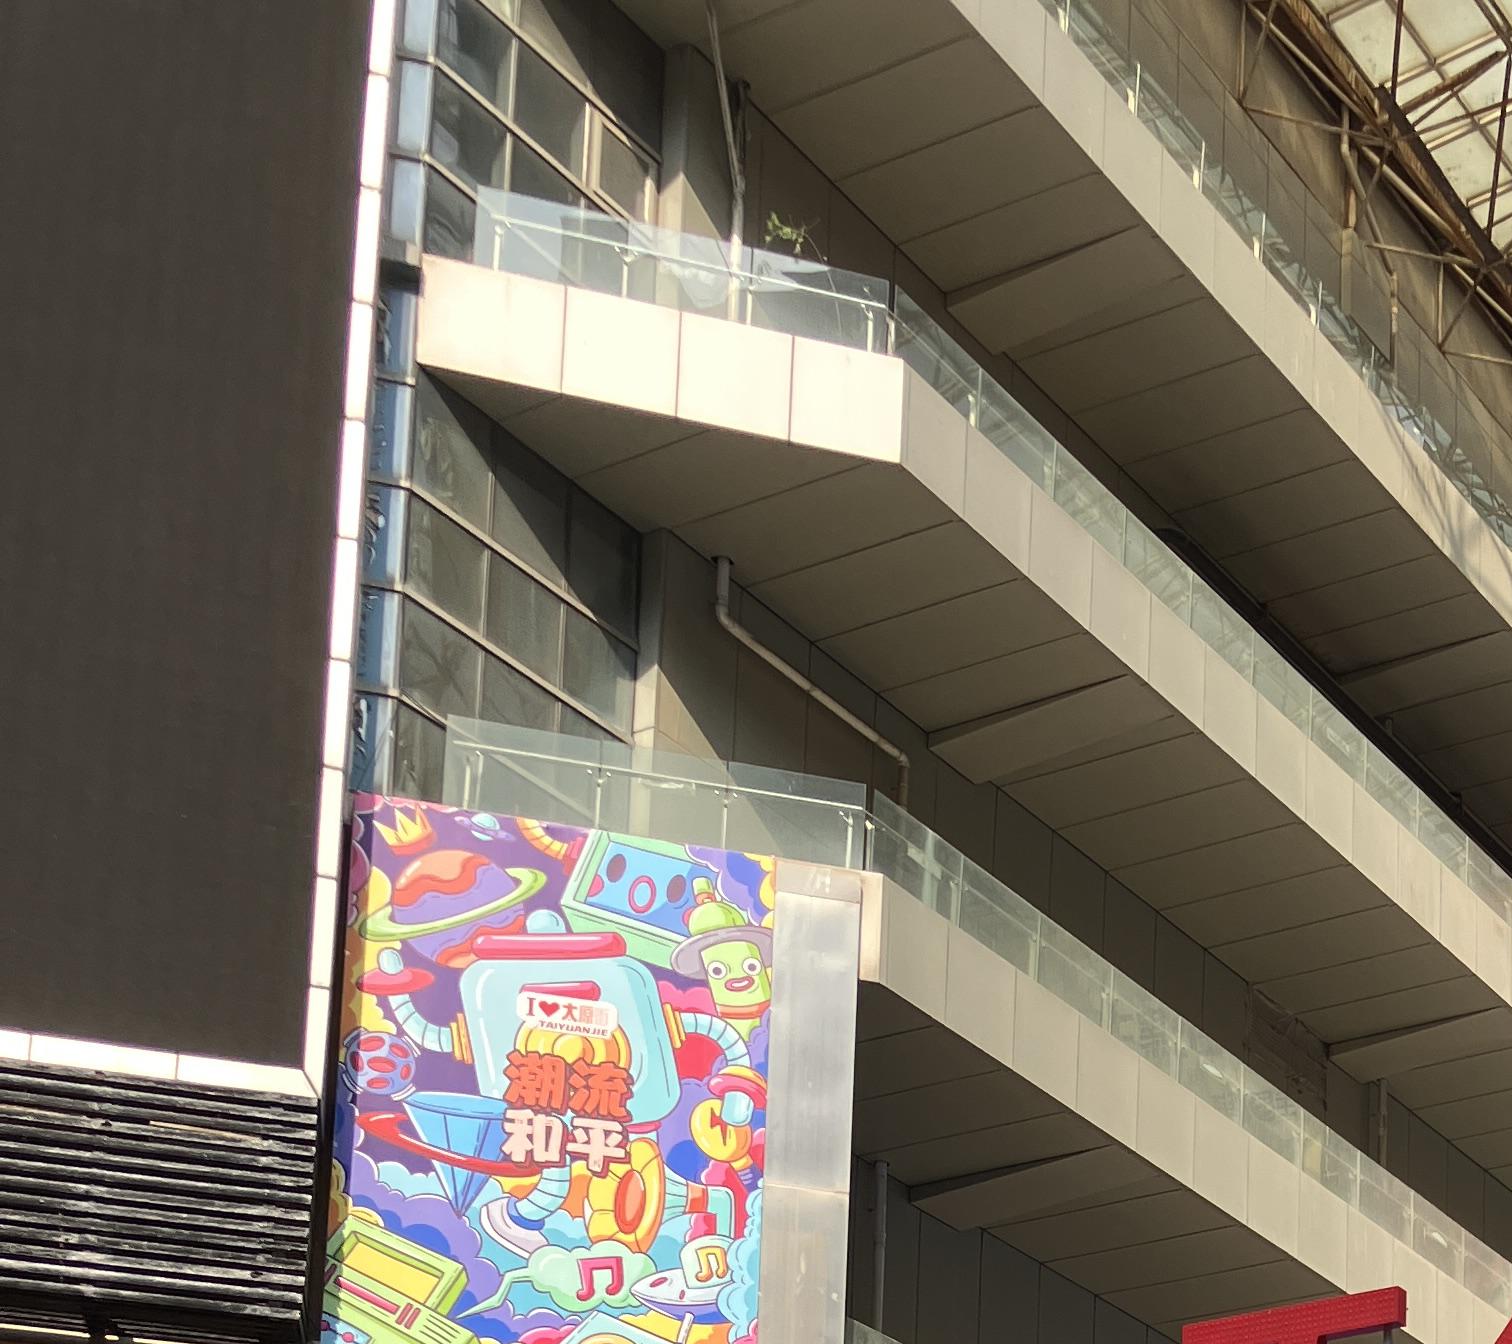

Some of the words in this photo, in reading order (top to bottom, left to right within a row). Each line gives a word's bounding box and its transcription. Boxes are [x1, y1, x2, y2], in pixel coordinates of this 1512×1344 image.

[538, 1019, 609, 1038] TAIYUANJIE
[503, 1049, 634, 1120] 潮流
[501, 1108, 630, 1178] 和平
